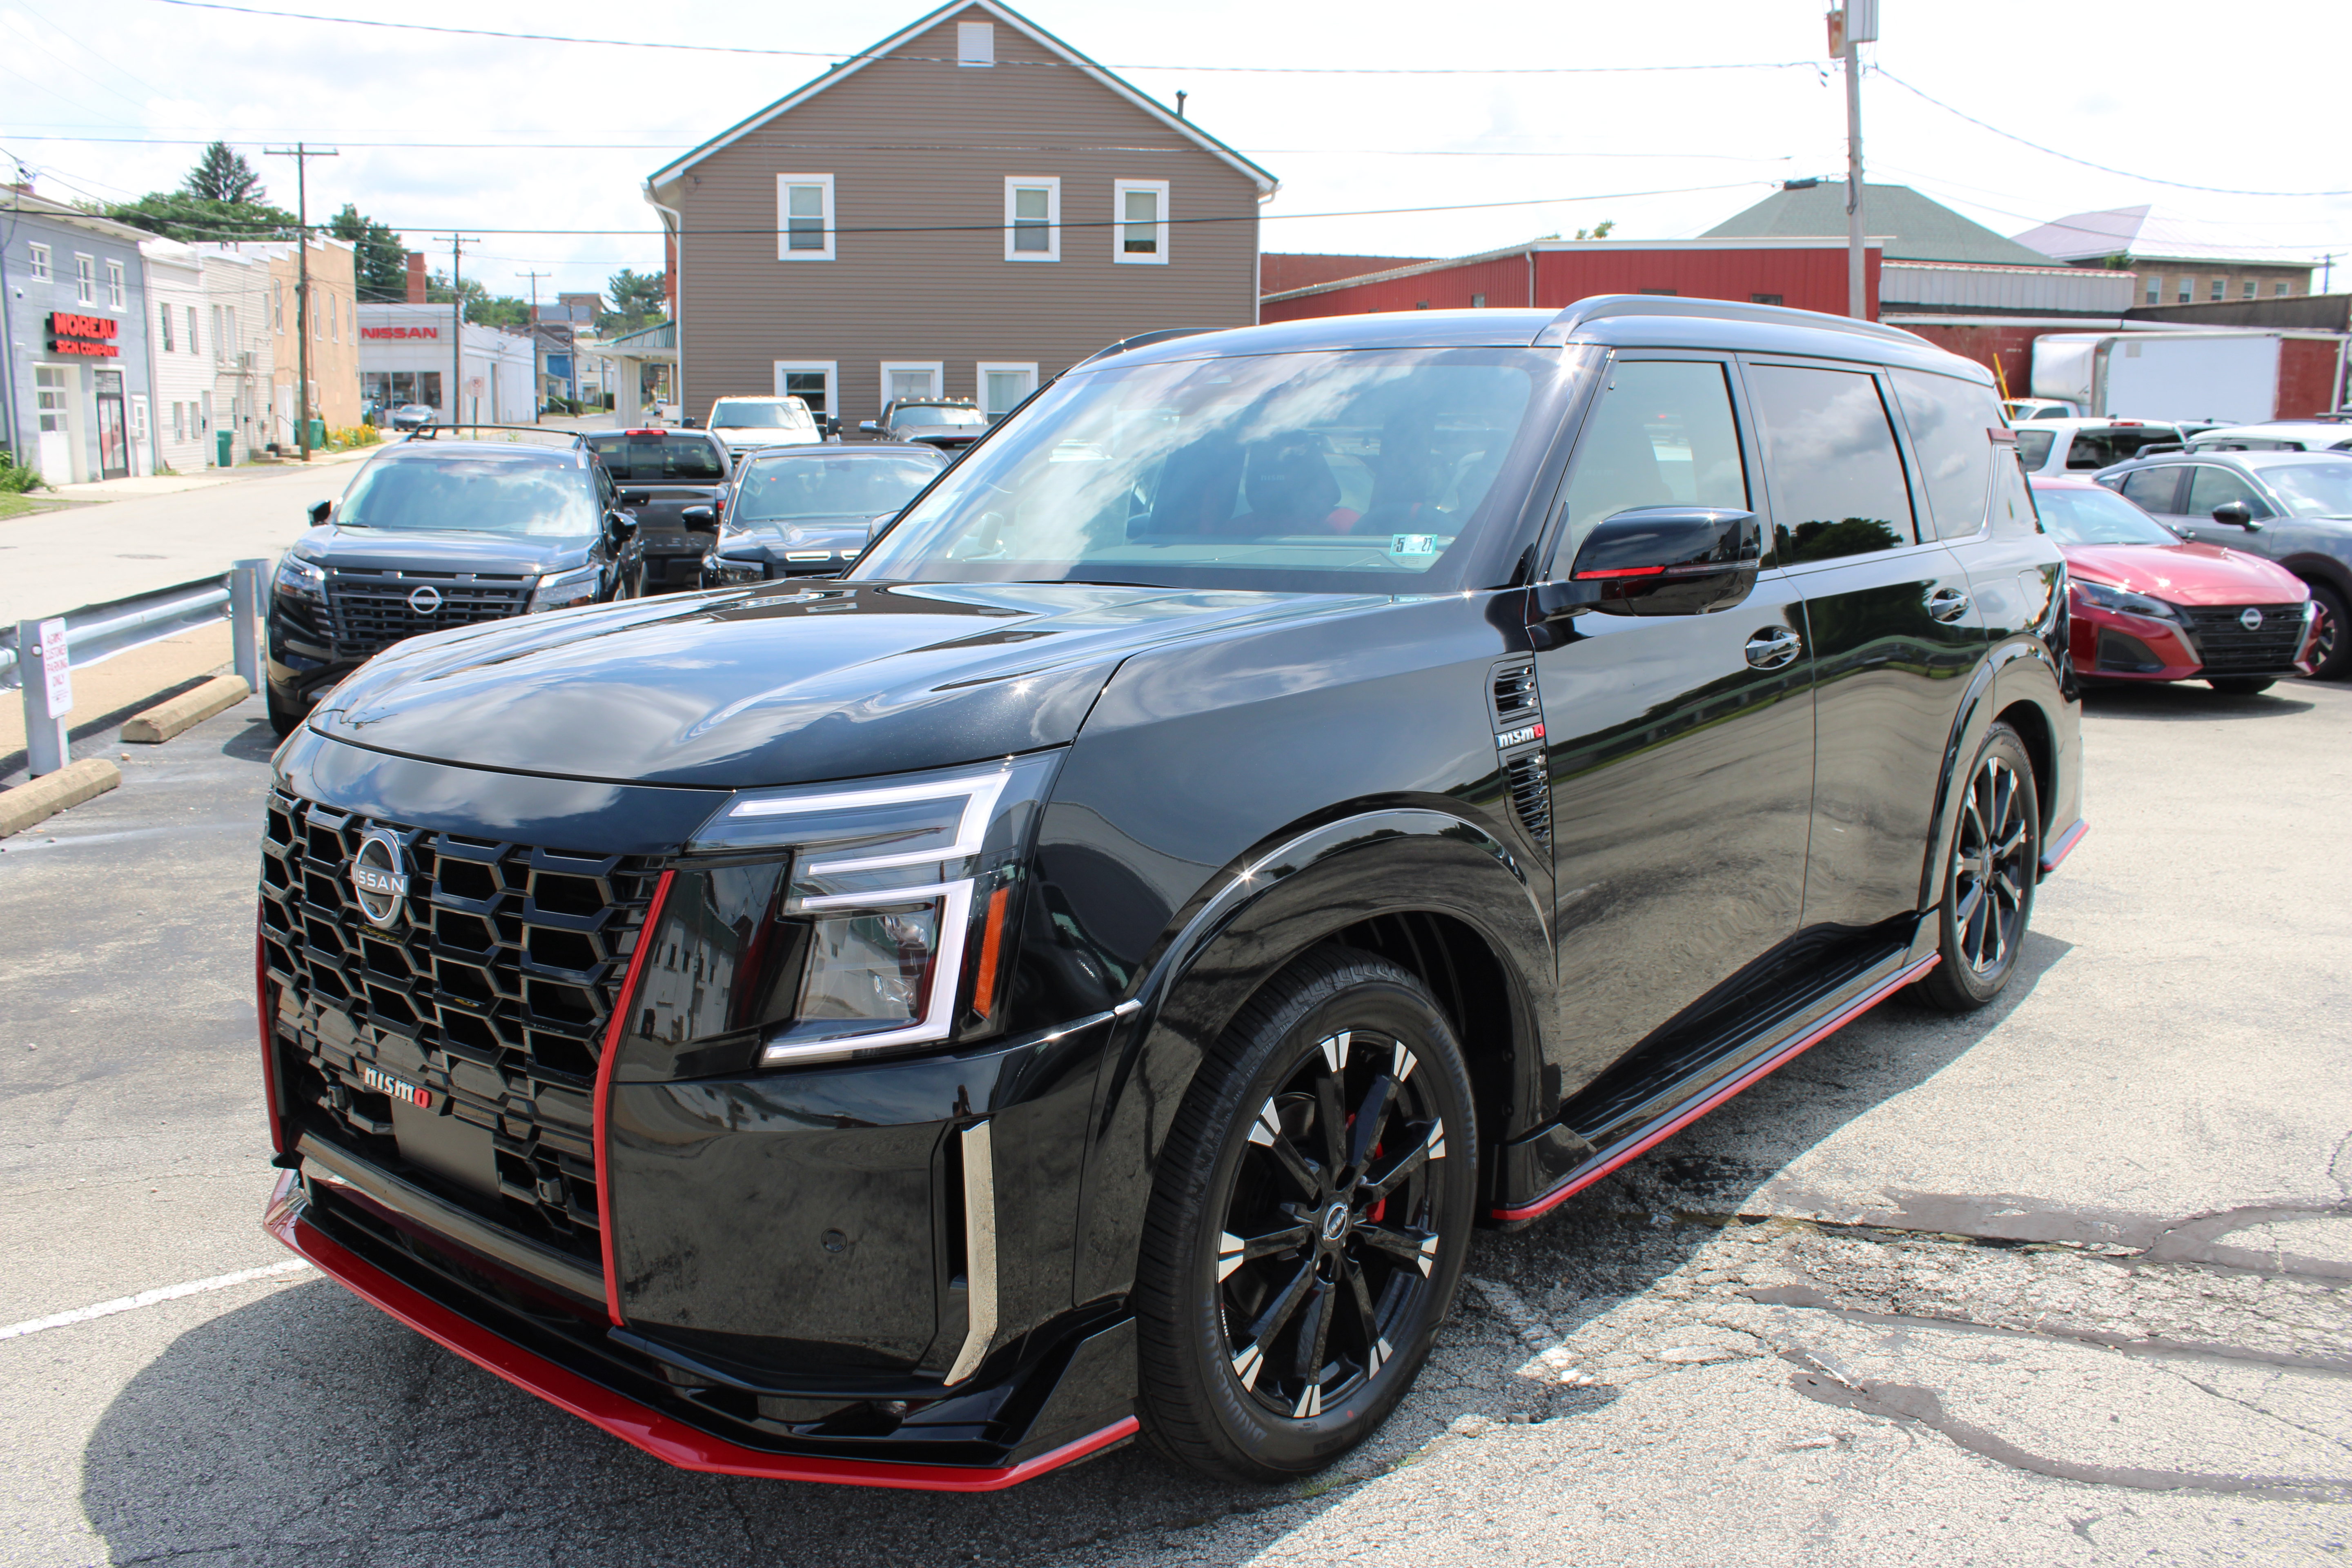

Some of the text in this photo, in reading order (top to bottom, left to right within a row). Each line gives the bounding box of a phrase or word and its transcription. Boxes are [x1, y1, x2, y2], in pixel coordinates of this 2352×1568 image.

[53, 312, 118, 339] MOREAU
[361, 327, 438, 339] NISSAN
[56, 340, 119, 357] SIGN COMPANY
[1396, 537, 1432, 552] 5 27
[1497, 724, 1545, 748] nismo
[365, 1067, 432, 1109] nismo
[1323, 1204, 1348, 1241] NISSAN
